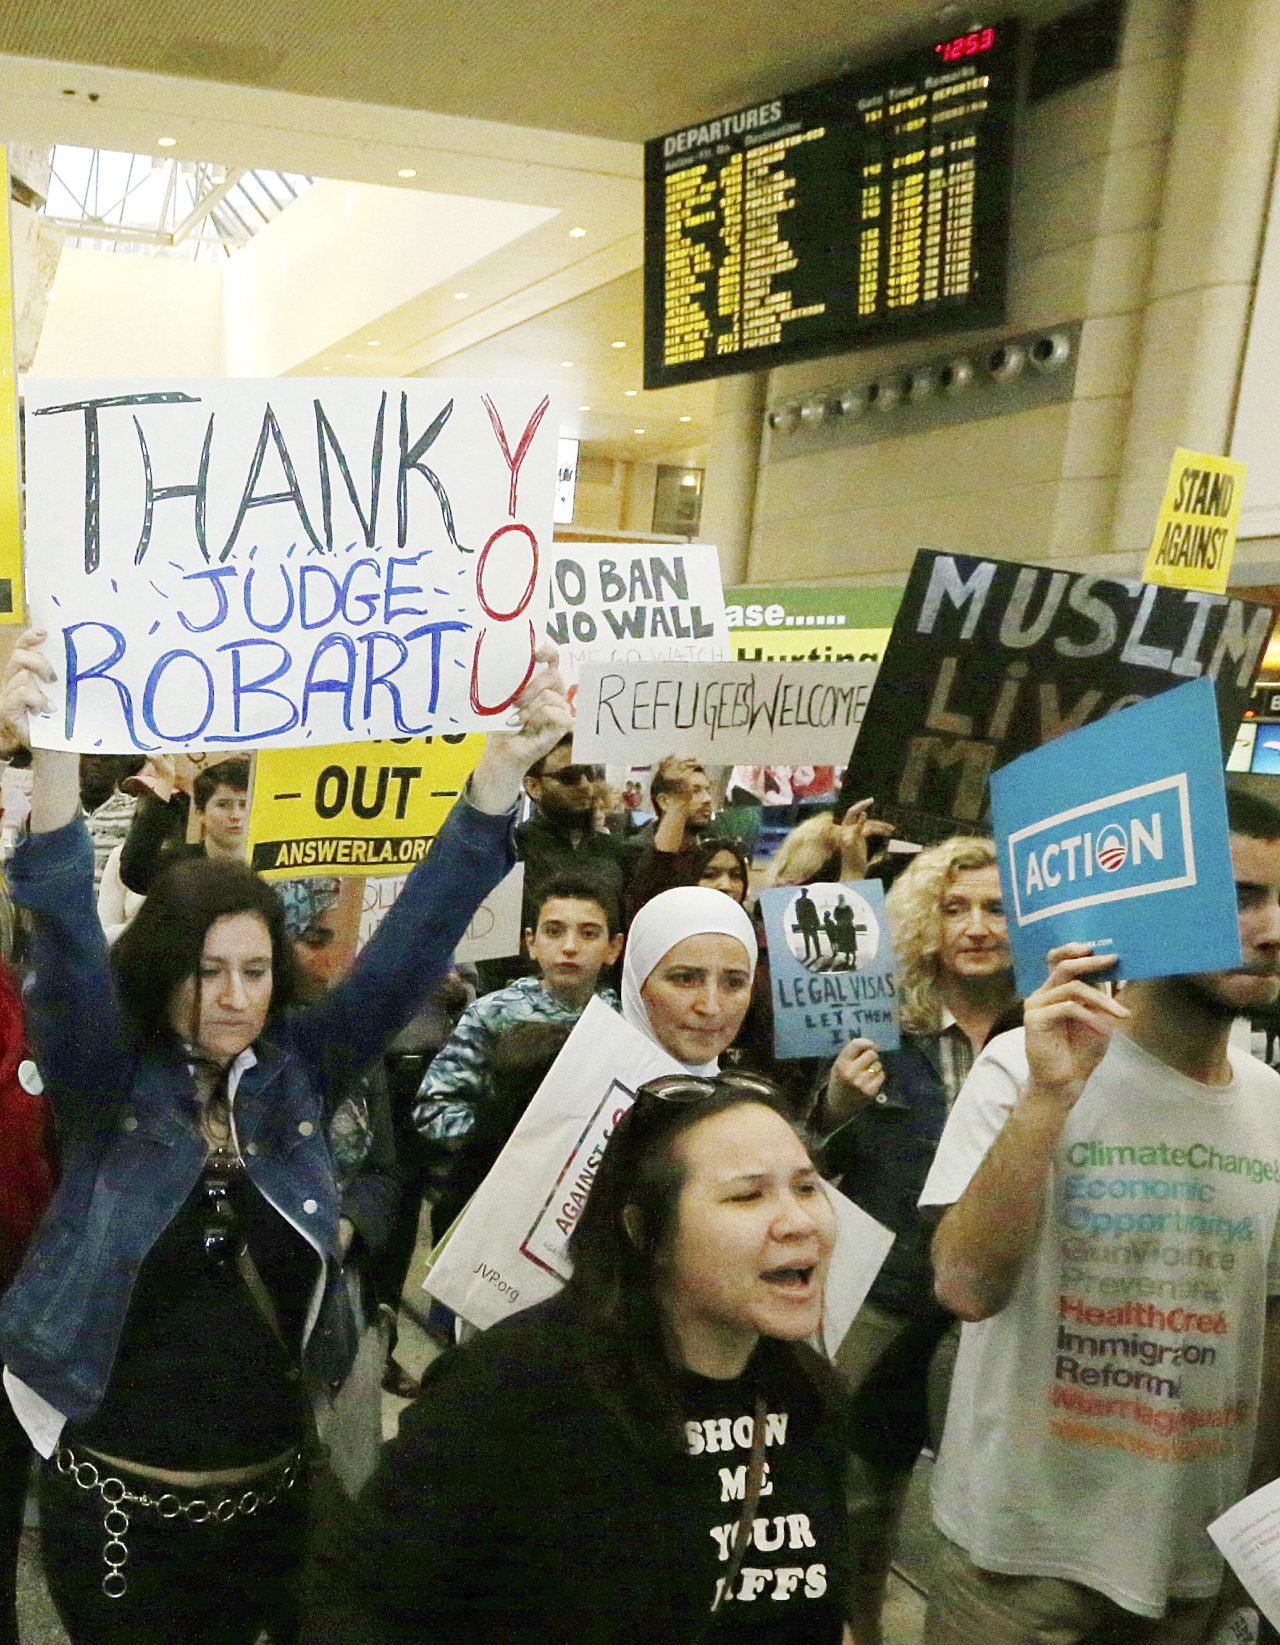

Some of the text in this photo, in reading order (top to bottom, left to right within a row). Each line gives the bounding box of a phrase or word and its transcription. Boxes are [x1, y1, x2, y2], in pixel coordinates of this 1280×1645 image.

[664, 102, 782, 157] DEPARTURES
[32, 390, 474, 575] THANK
[1173, 467, 1236, 518] STAND
[1155, 521, 1229, 571] AGAINST
[176, 550, 433, 633] JUDGE
[598, 556, 689, 603] BAN
[601, 605, 715, 640] WALL
[917, 556, 1273, 689] MUSLIM
[61, 620, 473, 752] ROBART
[595, 672, 869, 741] REFUGEES WELCOME
[314, 764, 423, 820] OUT
[1025, 813, 1163, 896] ACTION
[778, 972, 895, 1009] LEGAL VISAS
[804, 1009, 892, 1028] LET THEM
[831, 1027, 862, 1044] IN
[553, 1144, 604, 1236] AGAINST
[473, 1261, 520, 1303] JVP.org
